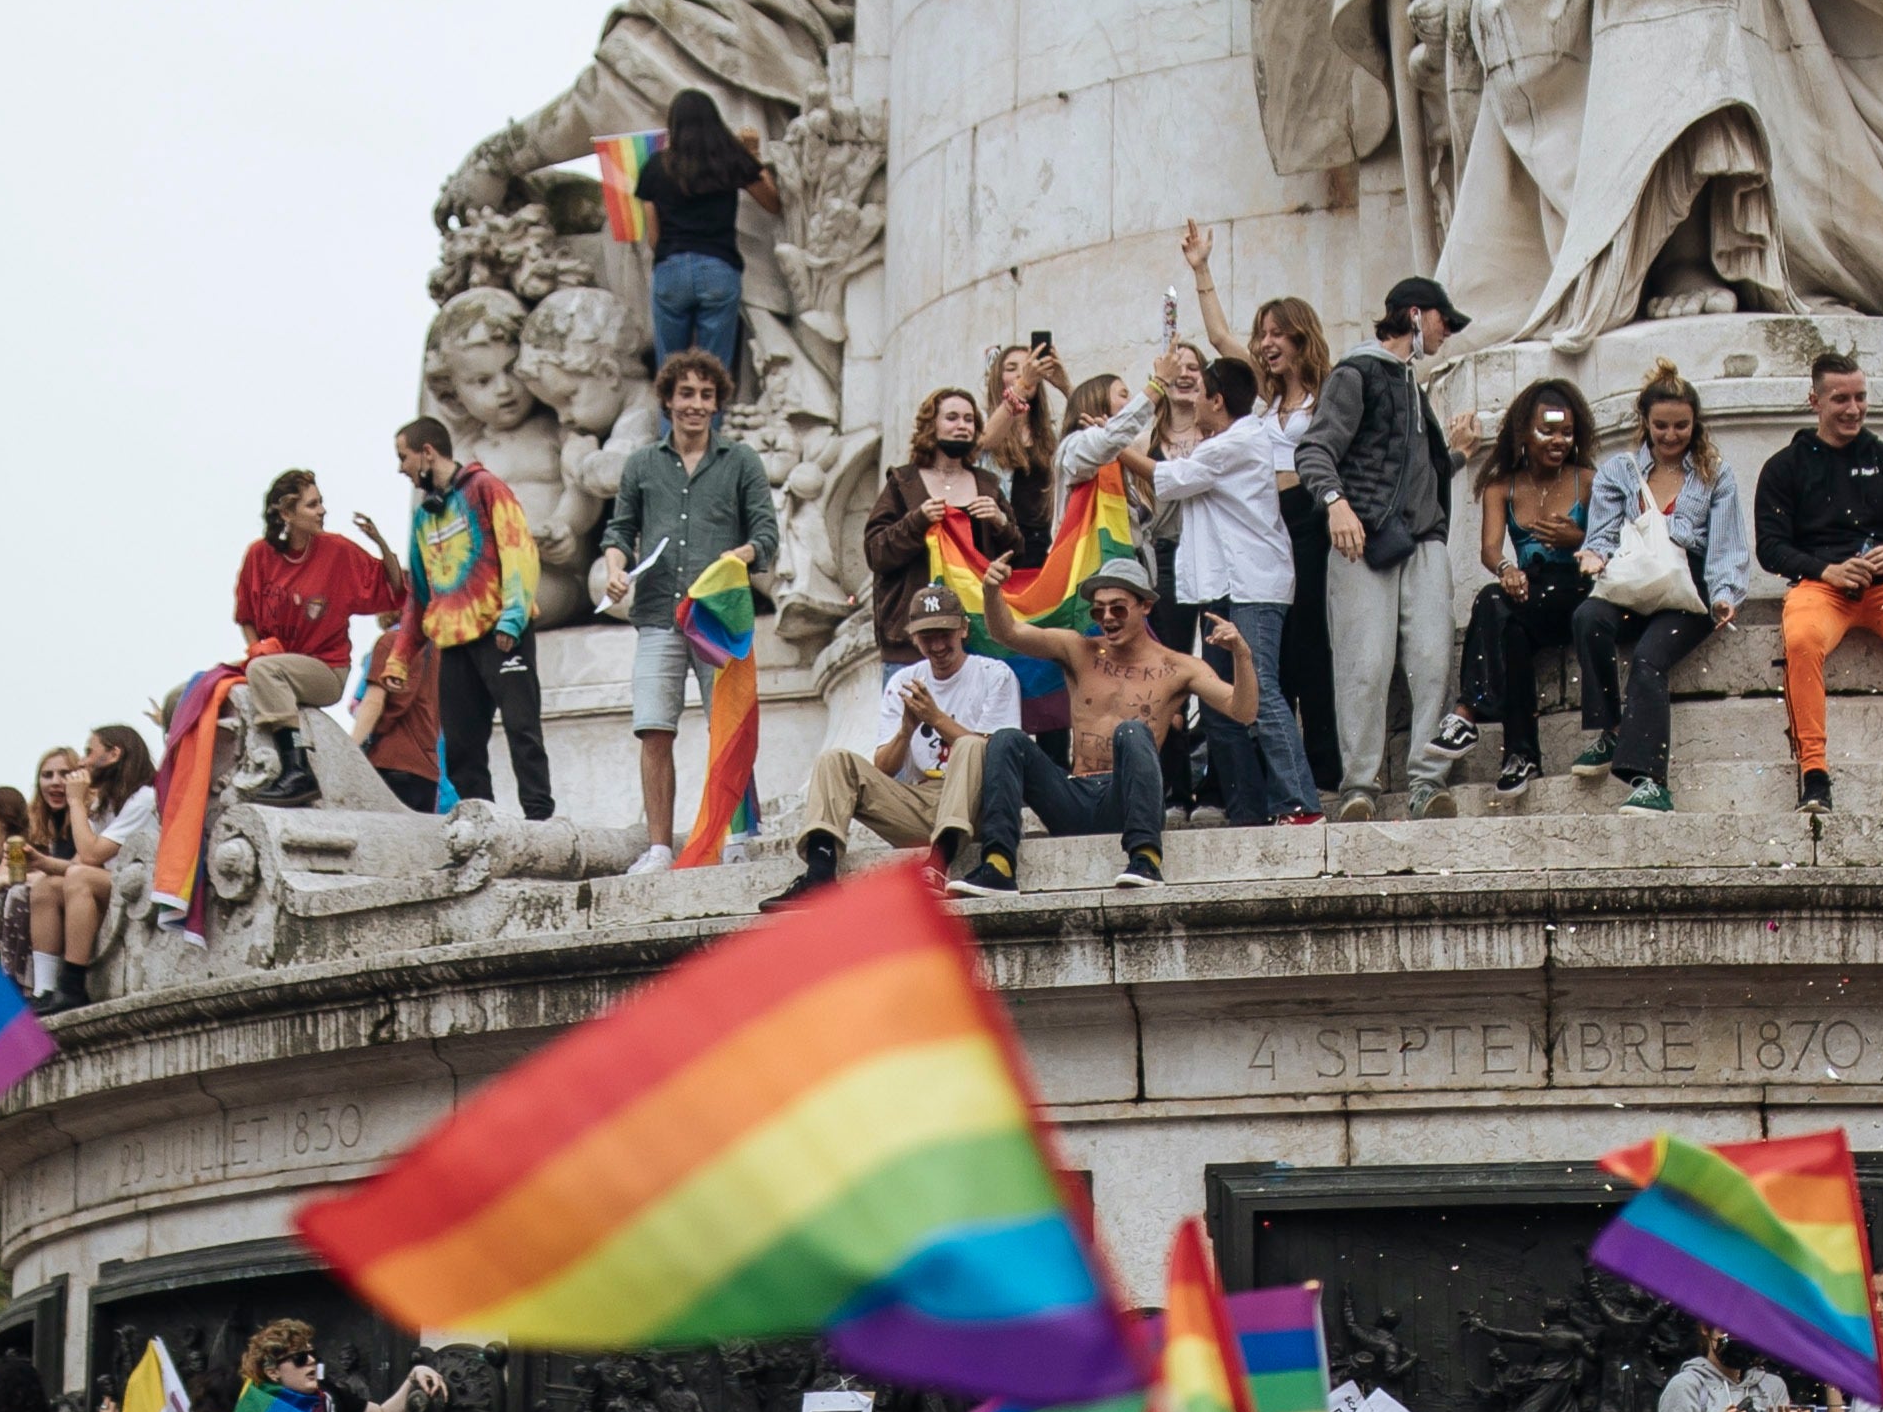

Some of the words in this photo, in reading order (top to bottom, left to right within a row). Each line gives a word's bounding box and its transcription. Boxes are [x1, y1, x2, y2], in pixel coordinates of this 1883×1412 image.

[1093, 656, 1135, 679] FREE
[1080, 732, 1113, 752] FRE
[1249, 1034, 1277, 1081] 4
[1316, 1022, 1697, 1079] SEPTEMBRE
[1734, 1019, 1865, 1072] 1870
[120, 1144, 145, 1187] 29
[155, 1117, 269, 1179] JUILLET
[282, 1104, 362, 1158] 1830
